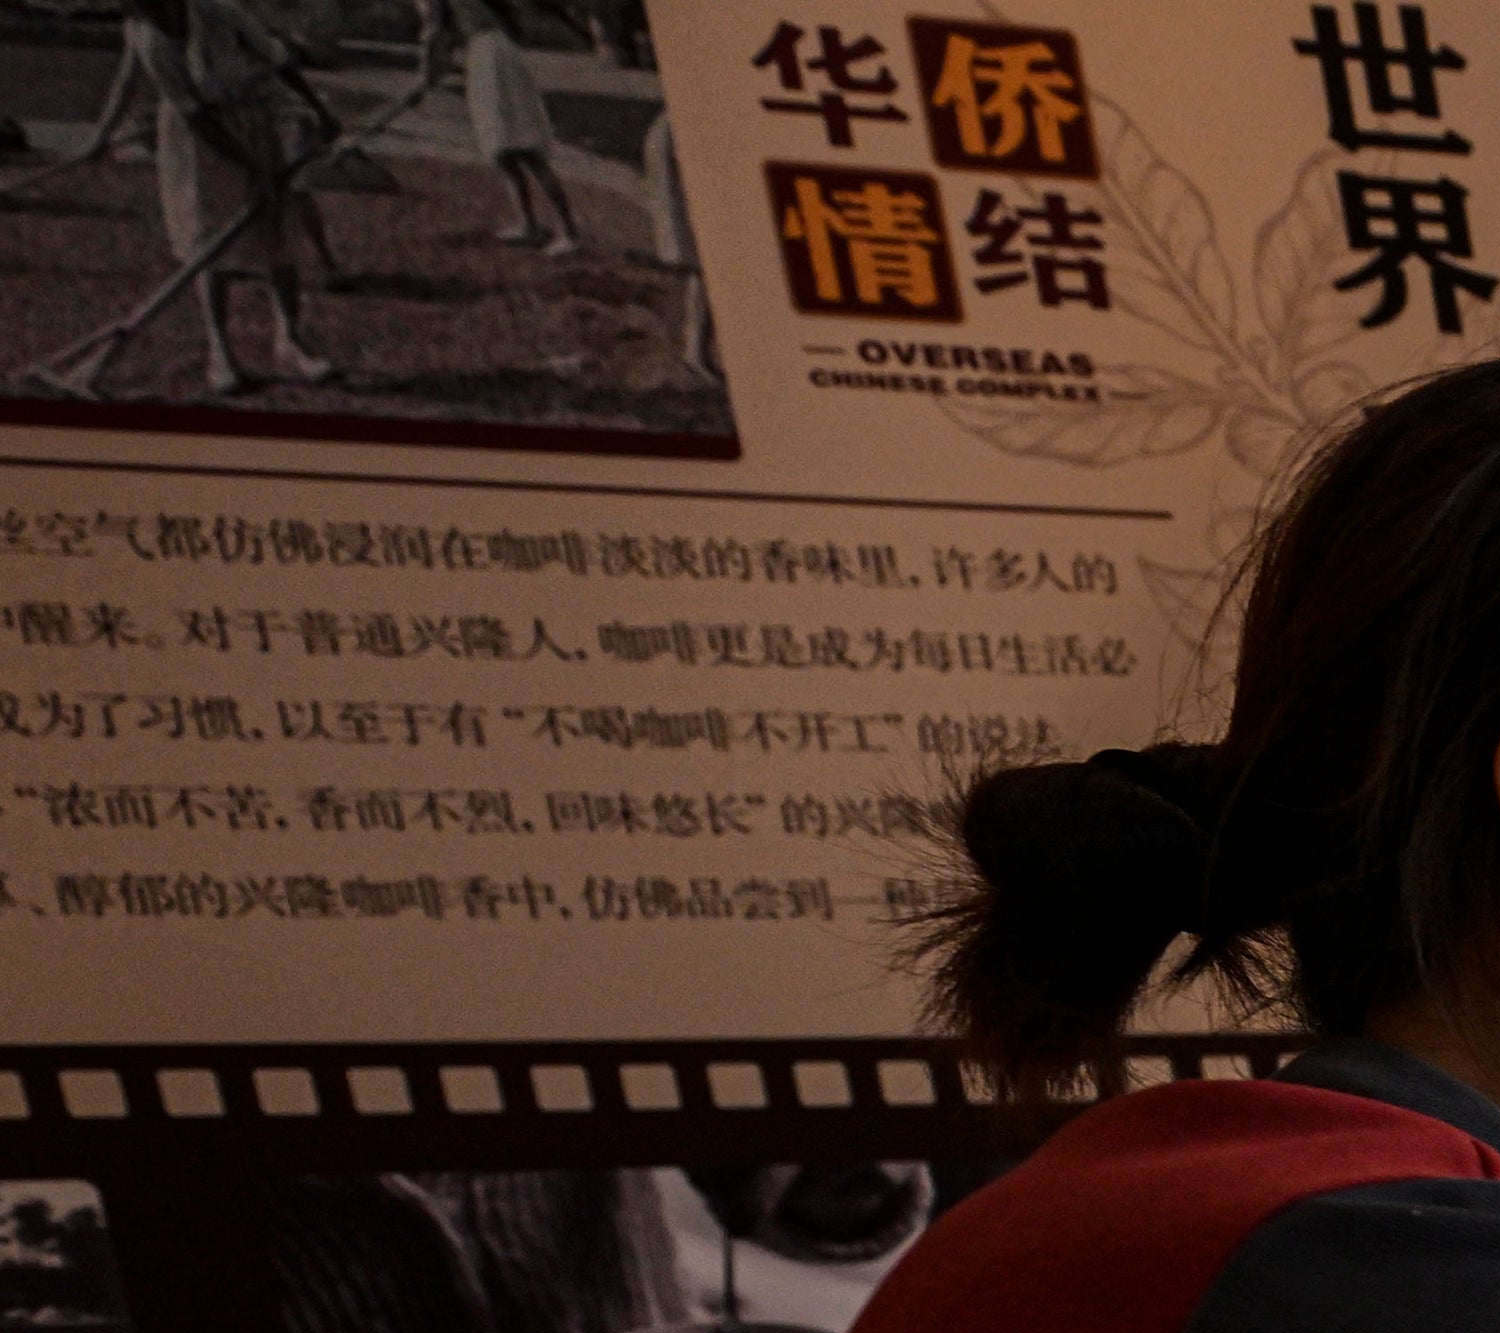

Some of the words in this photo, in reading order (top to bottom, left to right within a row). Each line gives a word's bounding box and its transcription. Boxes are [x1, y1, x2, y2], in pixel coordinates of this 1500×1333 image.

[752, 20, 1081, 163] 华侨
[1292, 0, 1499, 335] 世界
[783, 177, 1111, 310] 情结
[809, 367, 948, 396] CHINESE
[956, 377, 1100, 402] COMPLEX
[857, 338, 1096, 377] OVERSEAS
